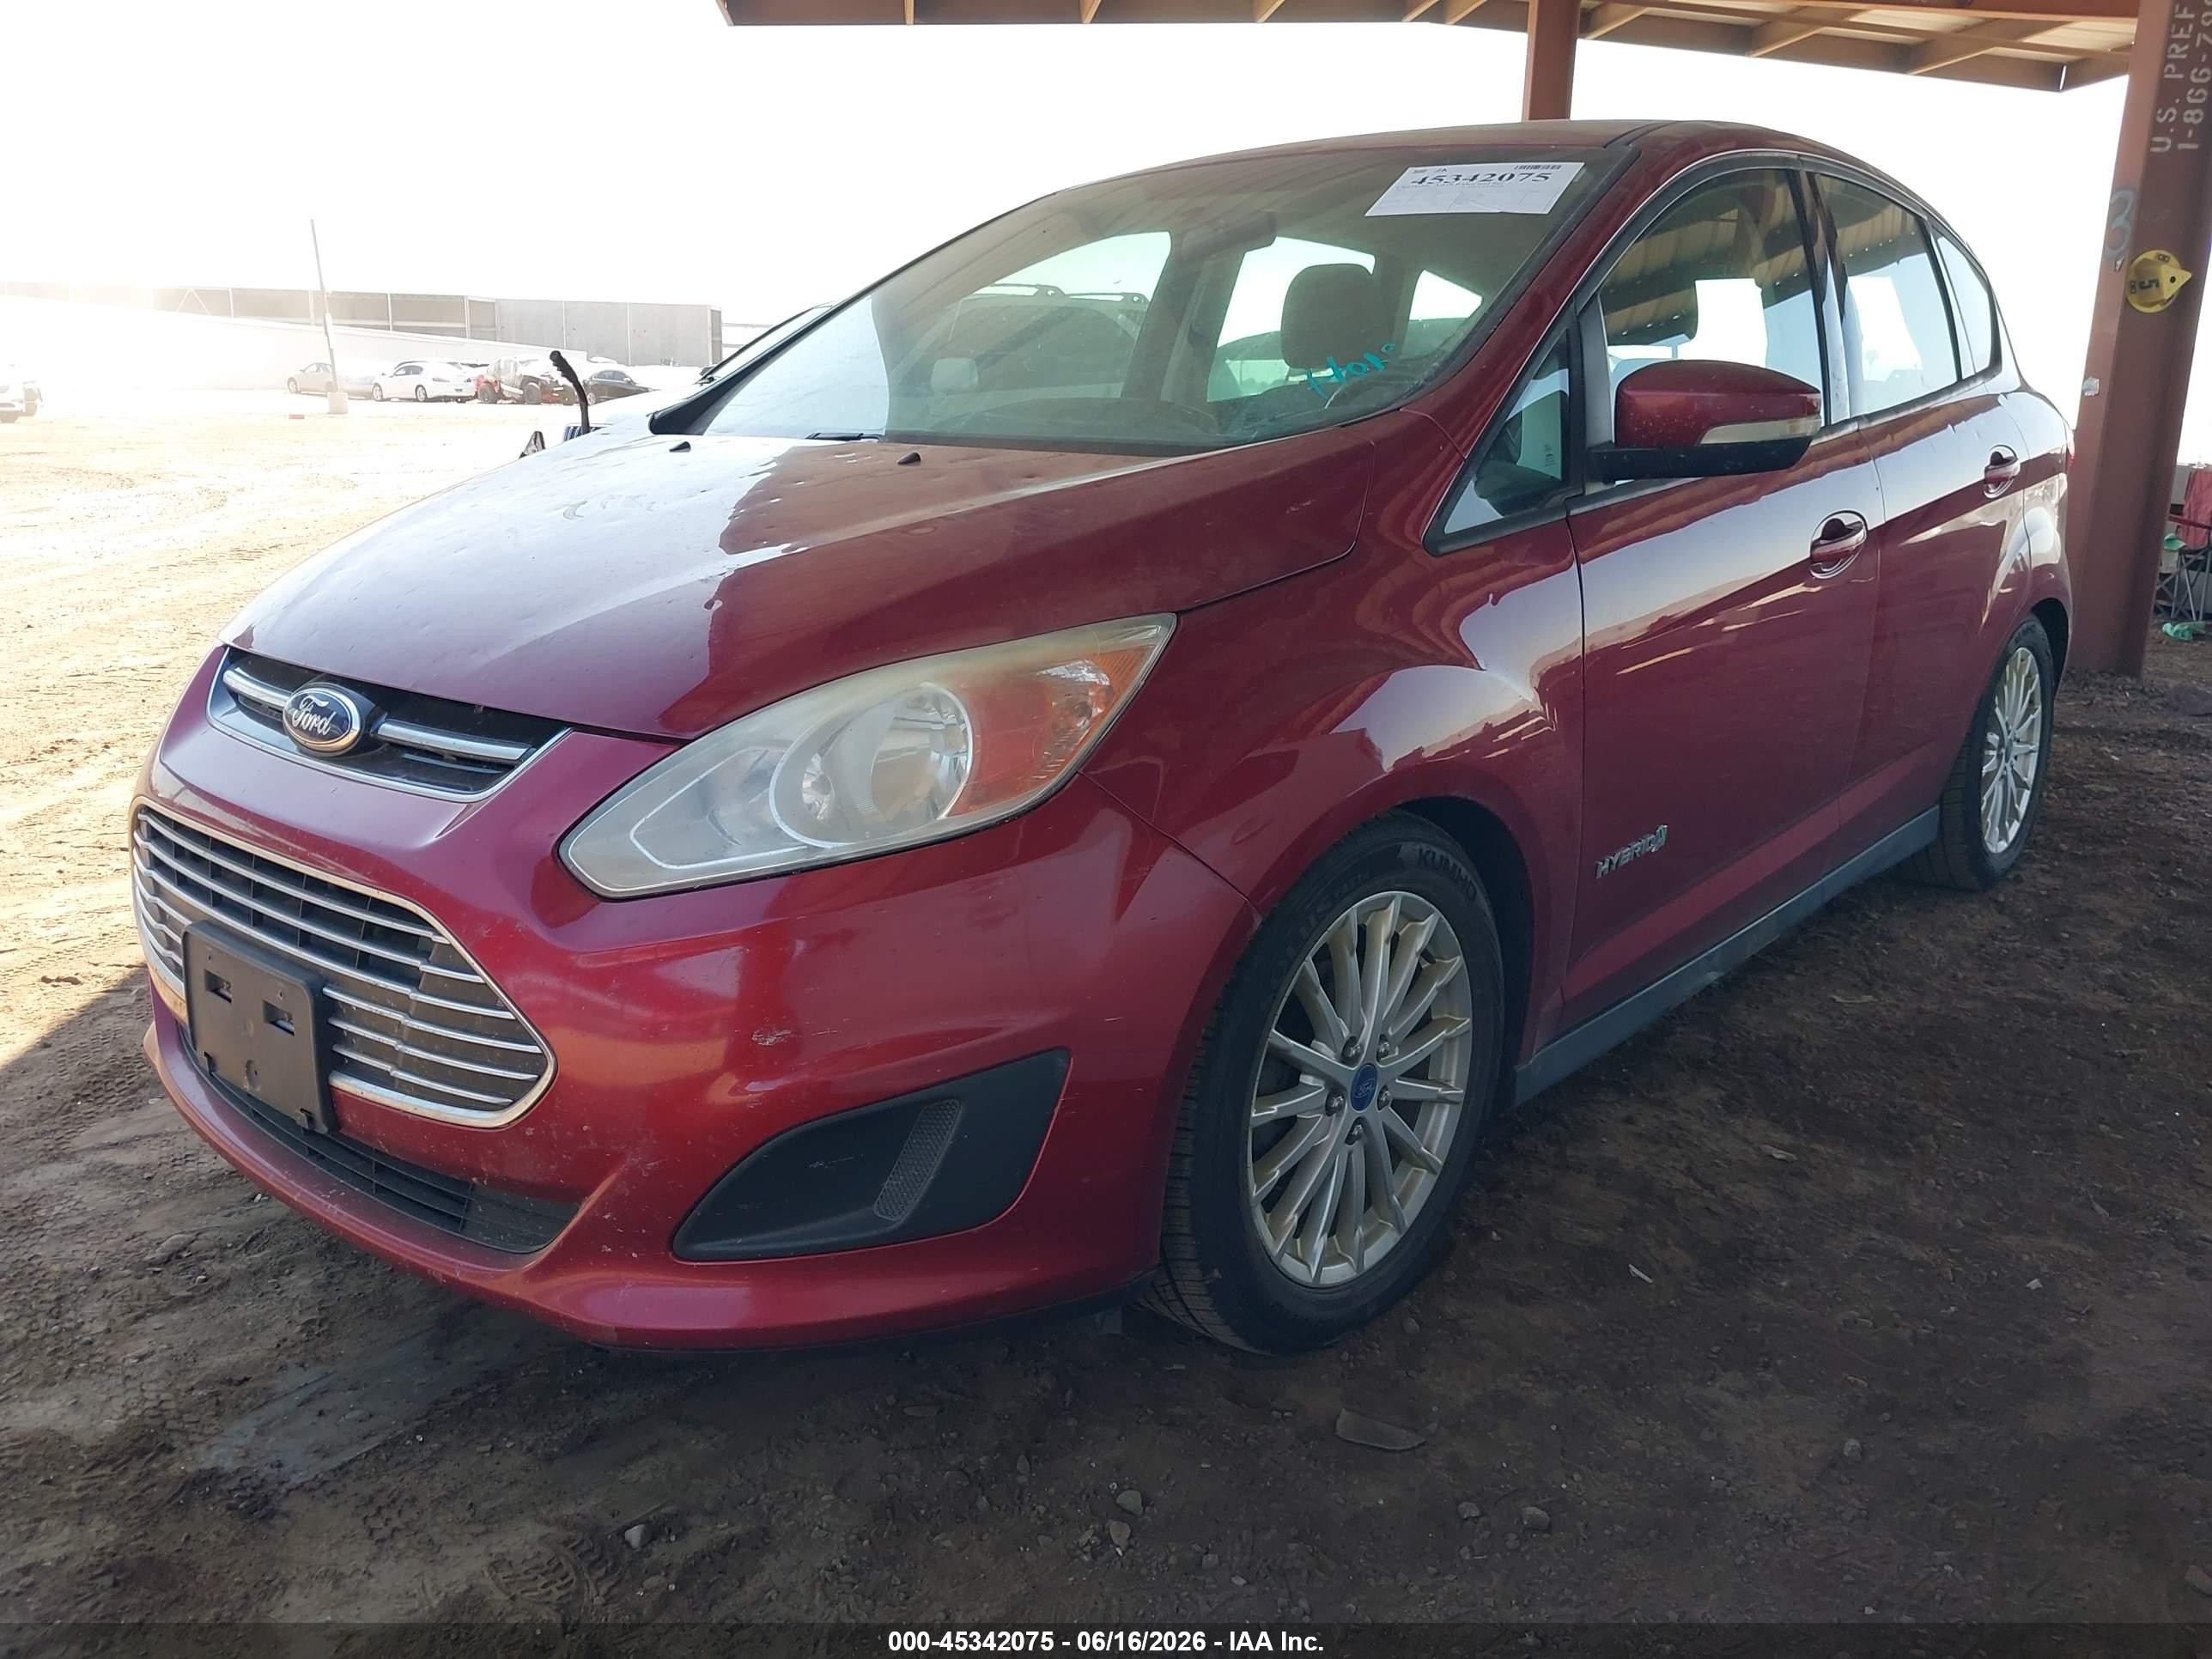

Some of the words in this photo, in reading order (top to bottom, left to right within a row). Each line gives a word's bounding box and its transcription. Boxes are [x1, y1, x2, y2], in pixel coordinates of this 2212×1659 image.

[2150, 99, 2179, 152] U.S.
[1412, 173, 1552, 185] 45342075
[292, 695, 337, 736] Ford
[1417, 848, 1477, 901] KUMHO
